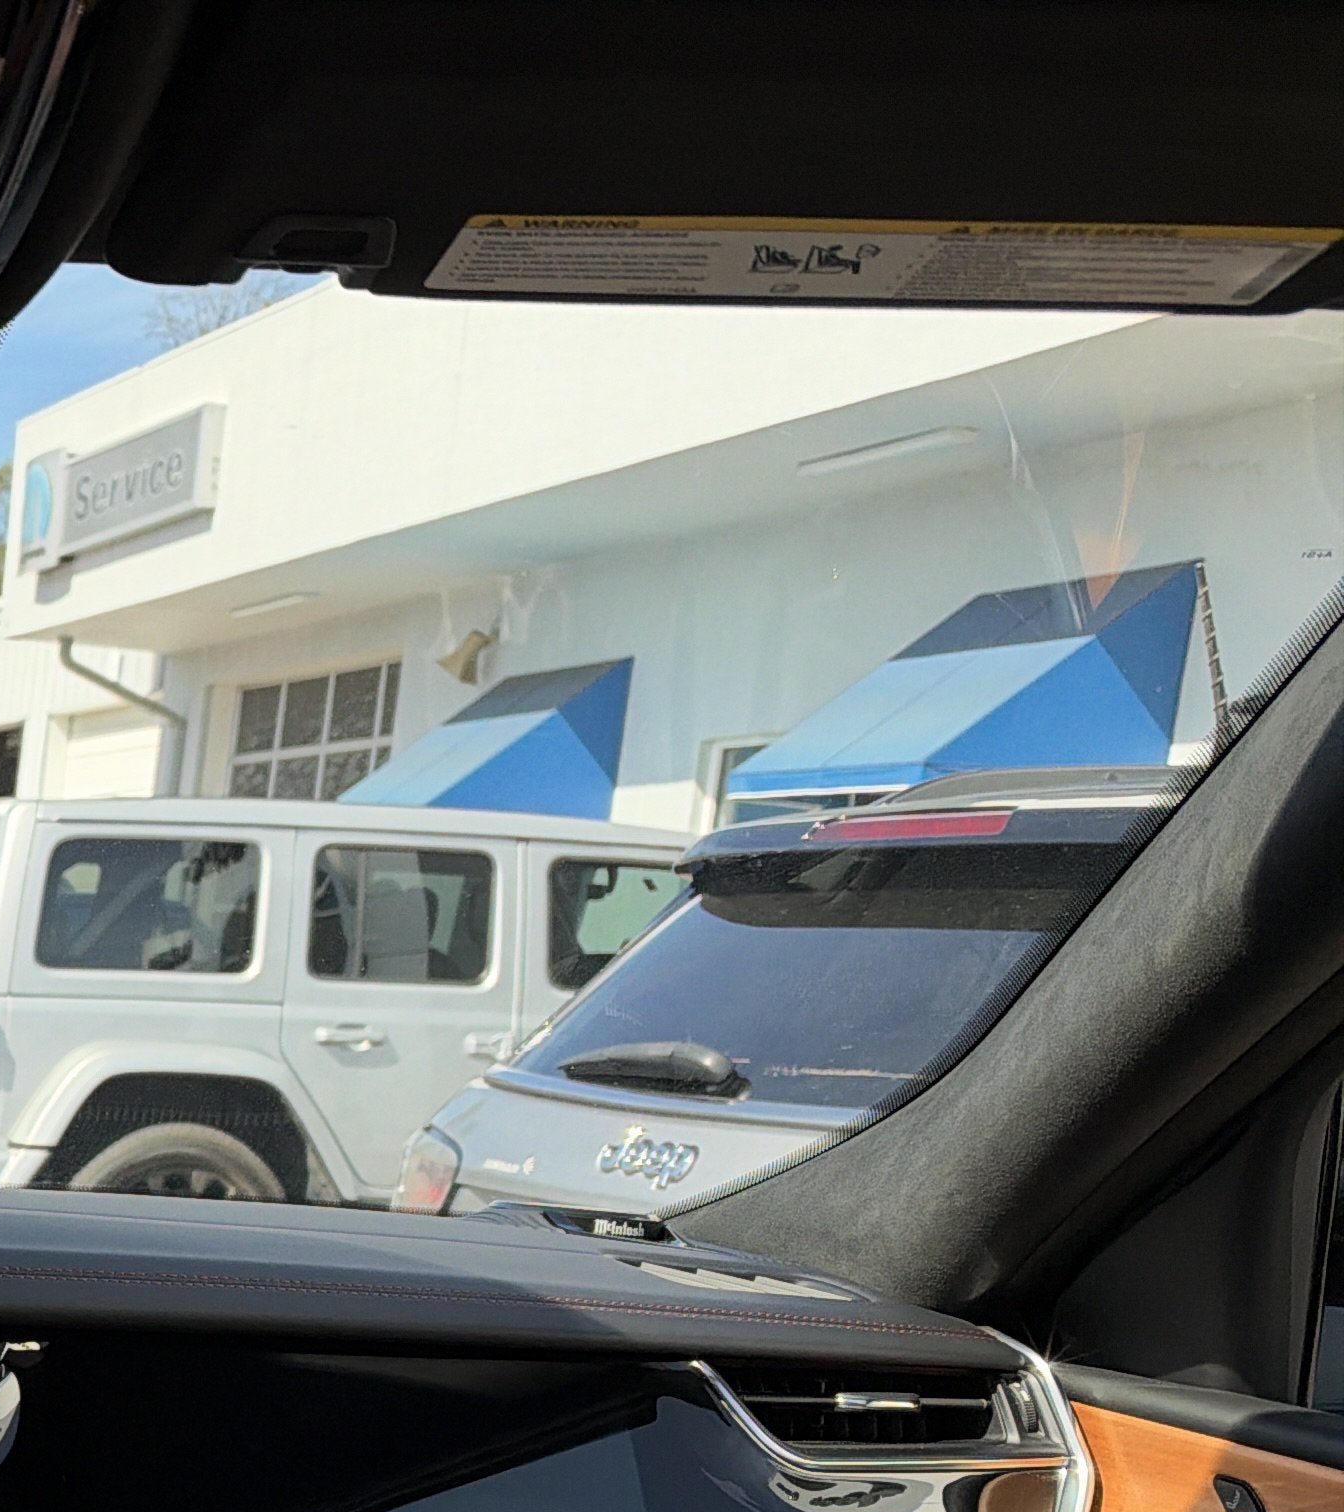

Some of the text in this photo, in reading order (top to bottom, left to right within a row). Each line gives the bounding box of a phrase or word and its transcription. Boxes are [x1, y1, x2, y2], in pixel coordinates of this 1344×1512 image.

[522, 218, 641, 230] WARNING
[74, 451, 183, 521] Service
[598, 1126, 699, 1191] Jeep
[594, 1219, 645, 1238] McIntosh
